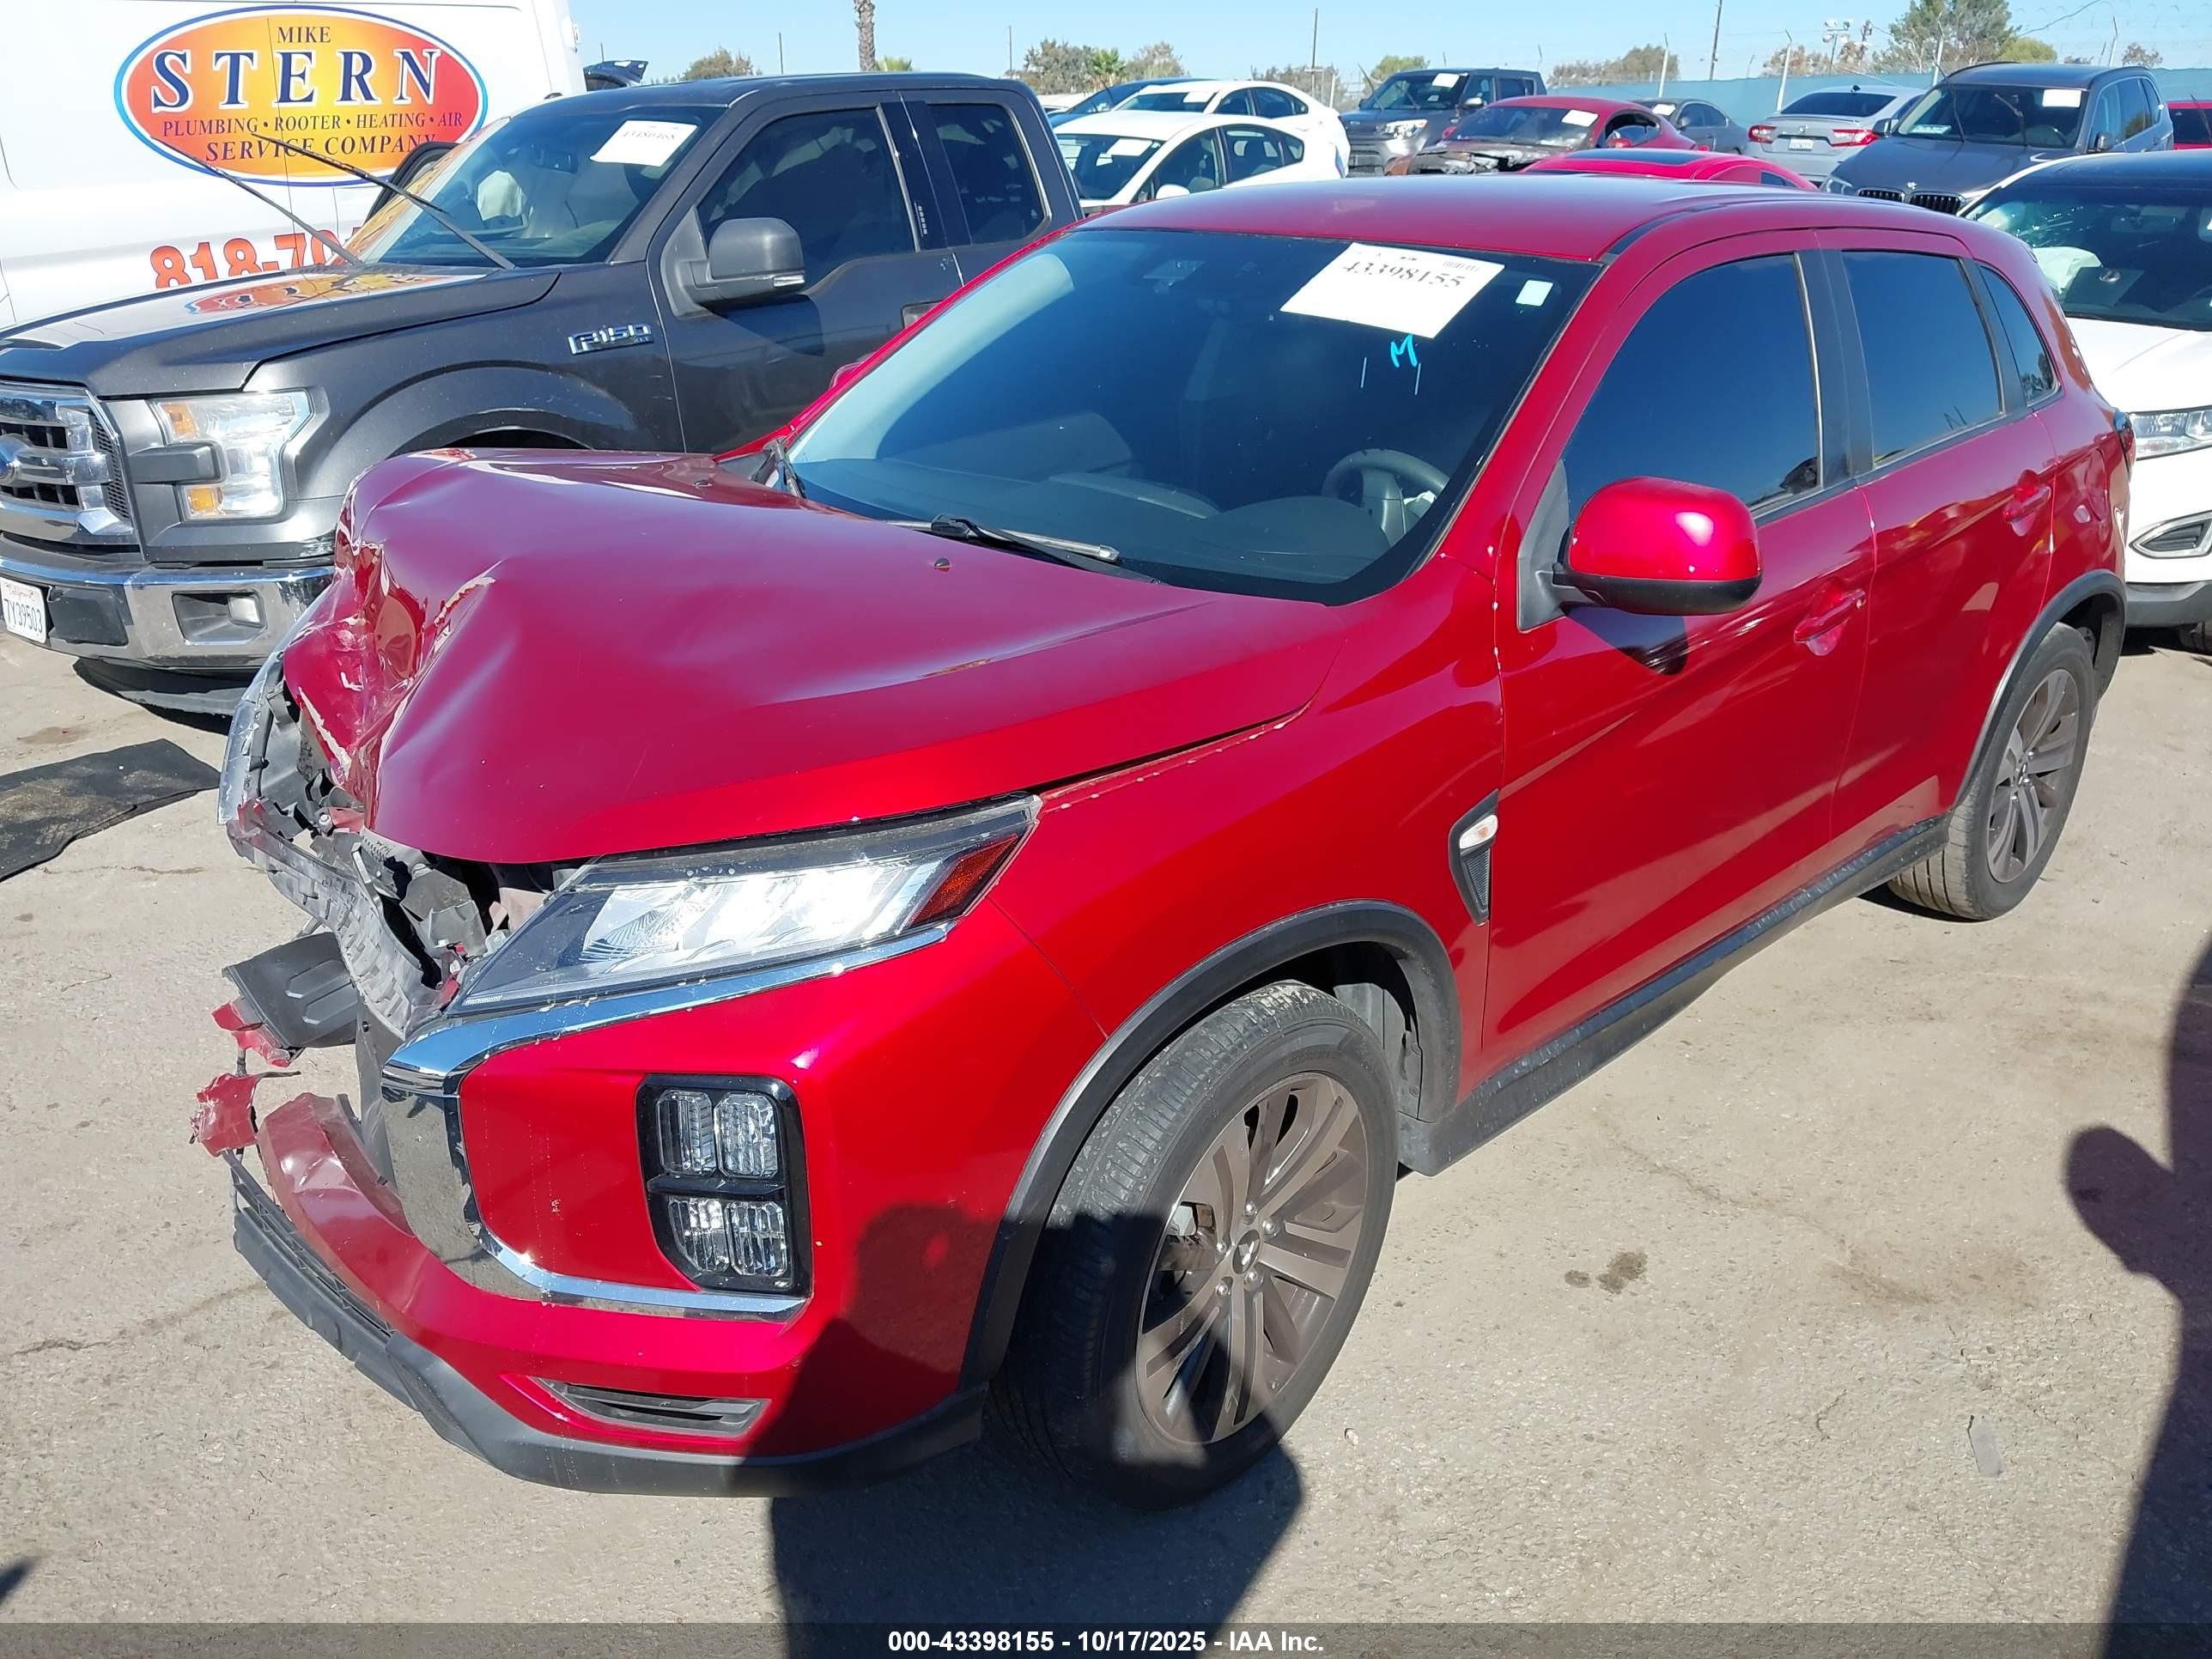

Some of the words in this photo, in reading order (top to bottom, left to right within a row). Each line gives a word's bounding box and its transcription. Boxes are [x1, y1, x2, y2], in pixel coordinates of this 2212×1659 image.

[277, 26, 331, 44] MIKE
[152, 48, 441, 113] STERN
[162, 117, 258, 137] PLUMBING
[274, 114, 342, 132] ROOTER
[356, 112, 426, 129] HEATING
[437, 112, 463, 127] AIR
[205, 137, 315, 162] SERVICE
[1342, 261, 1467, 288] 43398155
[1390, 333, 1419, 368] M
